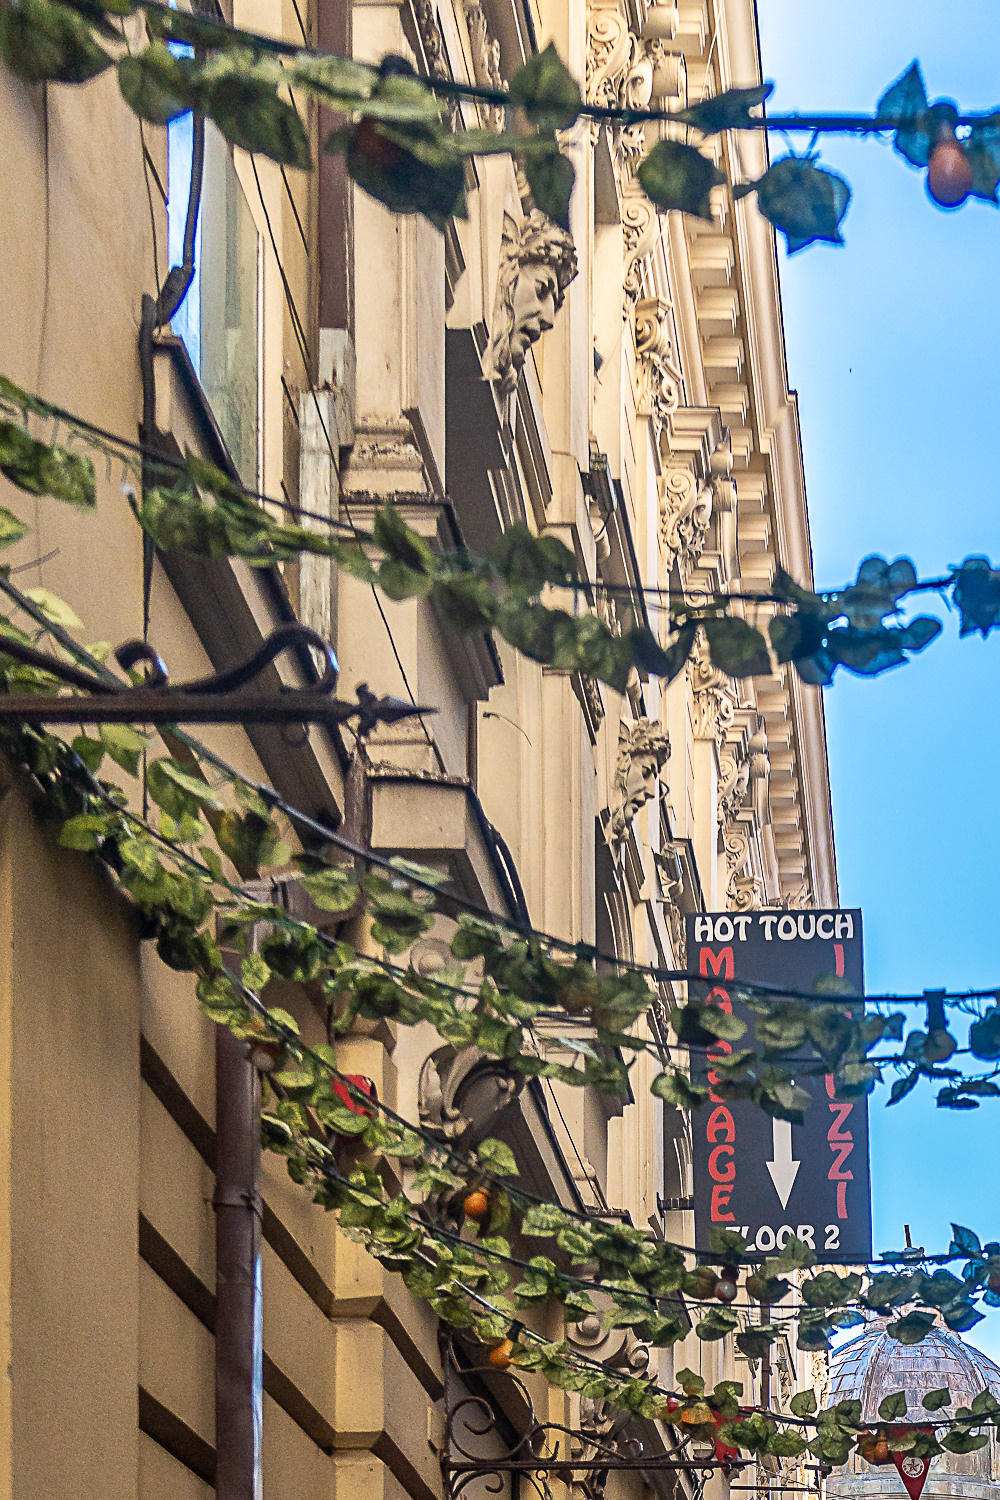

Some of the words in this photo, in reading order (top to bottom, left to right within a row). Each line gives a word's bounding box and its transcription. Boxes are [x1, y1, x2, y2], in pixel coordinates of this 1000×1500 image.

[694, 915, 752, 943] HOT
[758, 913, 855, 941] TOUCH
[726, 1225, 816, 1251] LOOR
[824, 1224, 840, 1250] 2
